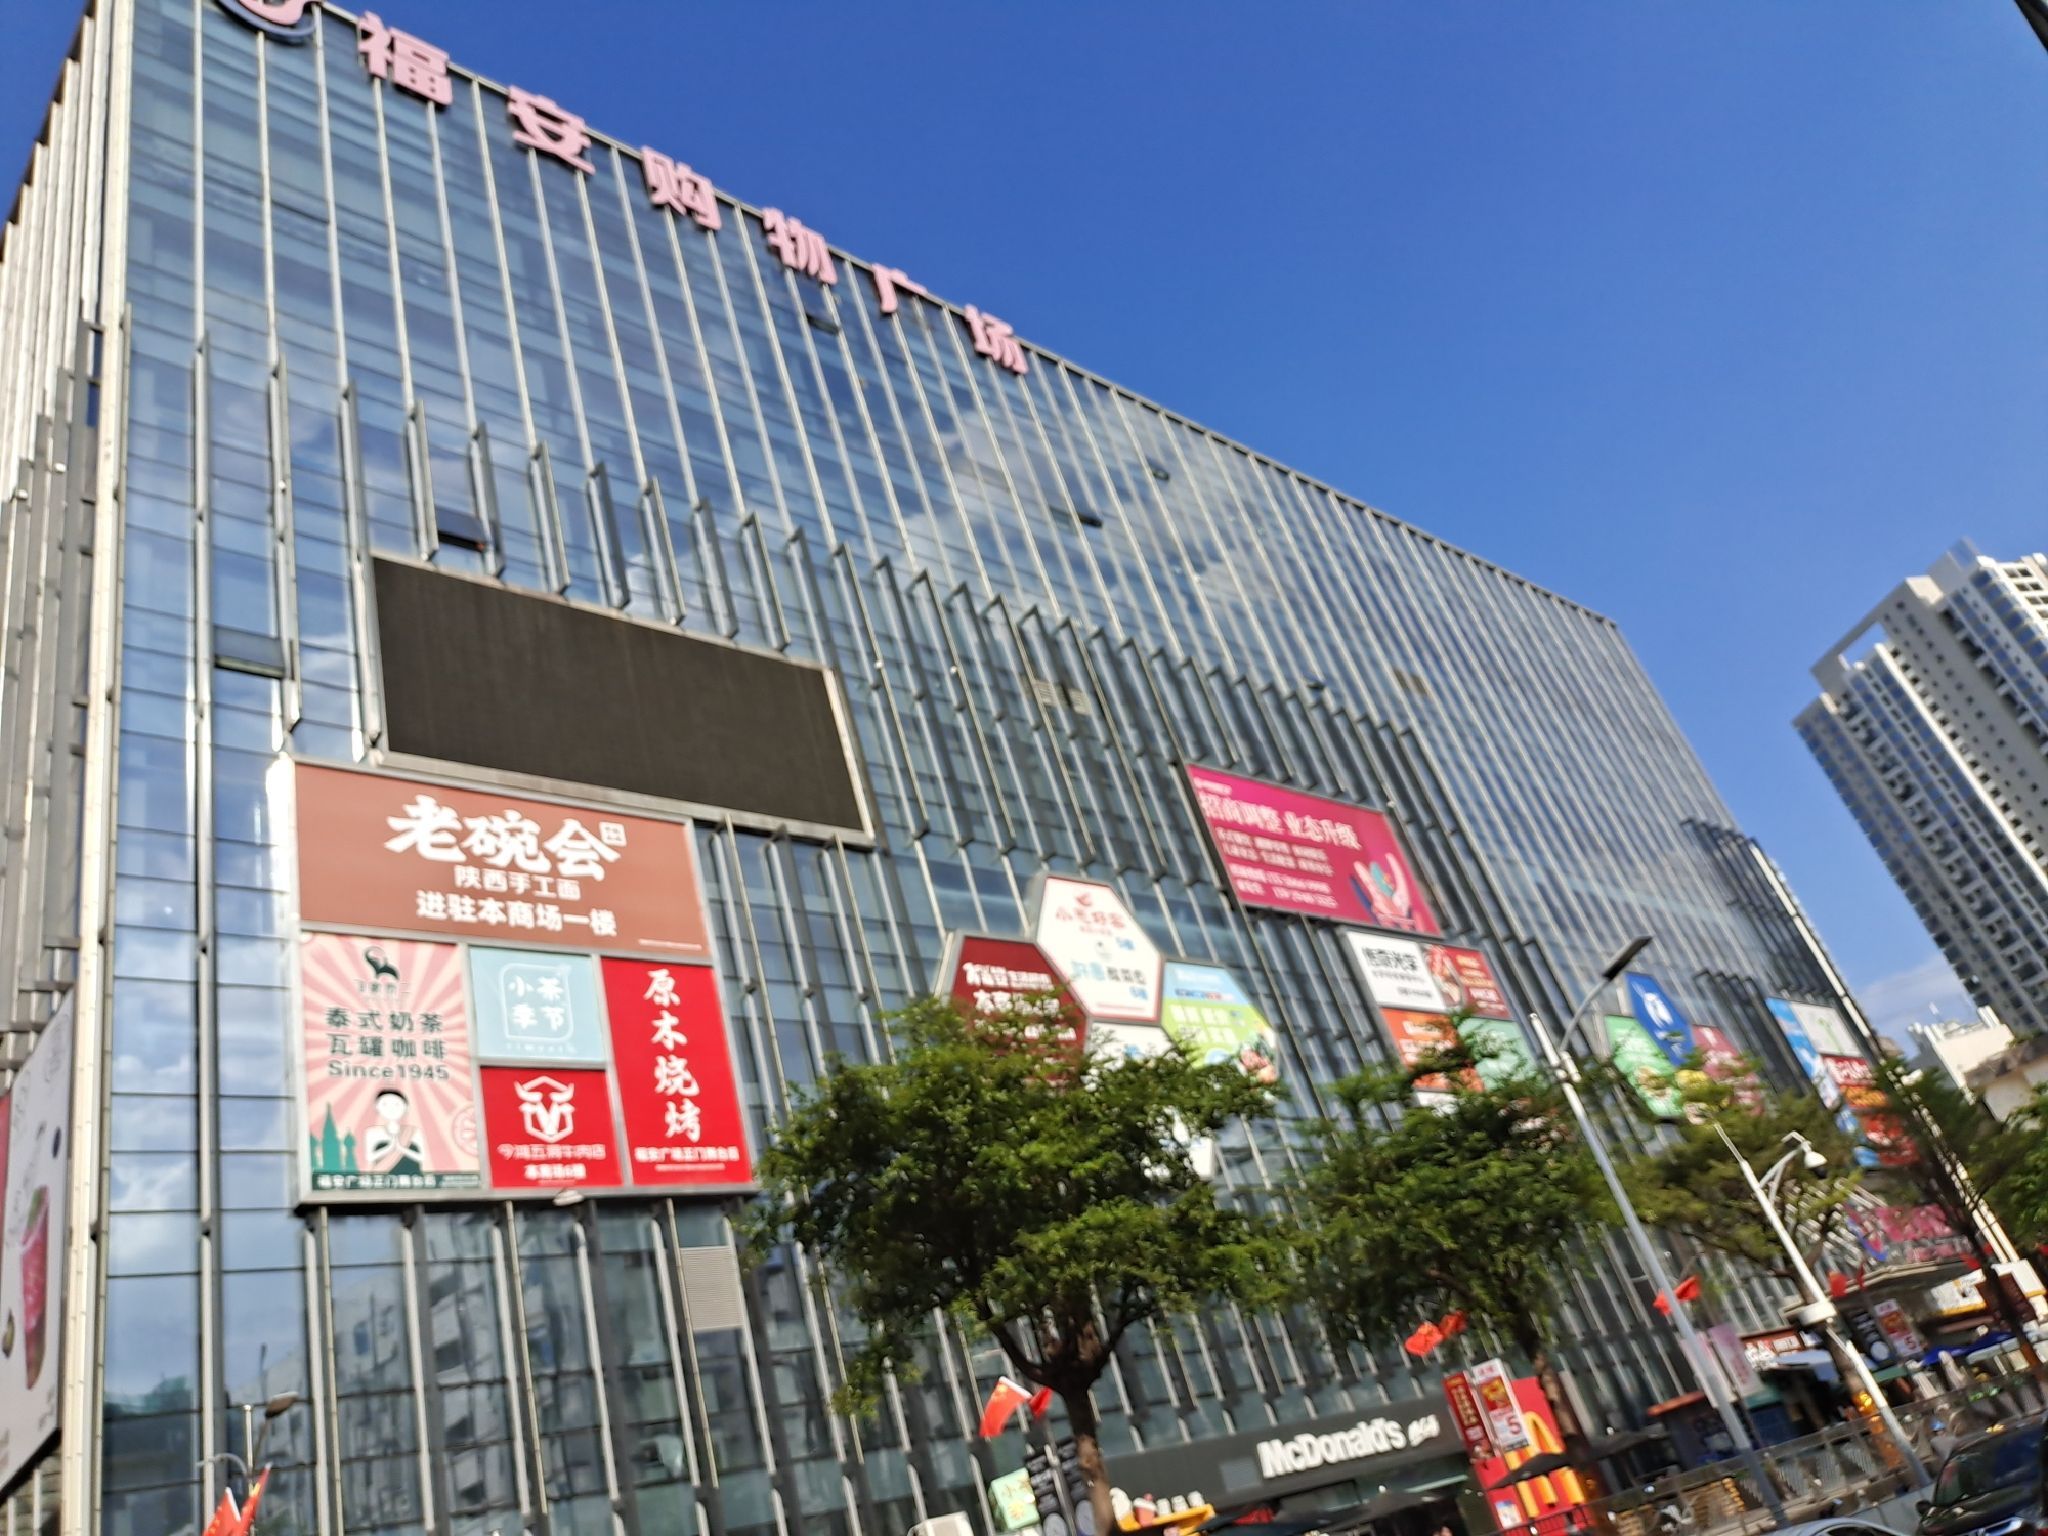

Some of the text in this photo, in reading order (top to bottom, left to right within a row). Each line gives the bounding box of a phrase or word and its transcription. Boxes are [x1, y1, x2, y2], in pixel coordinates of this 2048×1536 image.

[358, 13, 1028, 375] 福安购物广场
[384, 795, 621, 881] 老碗会
[454, 864, 581, 901] 陕西手工面
[416, 890, 617, 937] 进驻本商场一楼
[326, 1007, 443, 1033] 泰式奶茶
[326, 1033, 447, 1060] 瓦罐咖啡
[644, 969, 701, 1142] 原木烧烤
[1256, 1417, 1407, 1478] McDonald's
